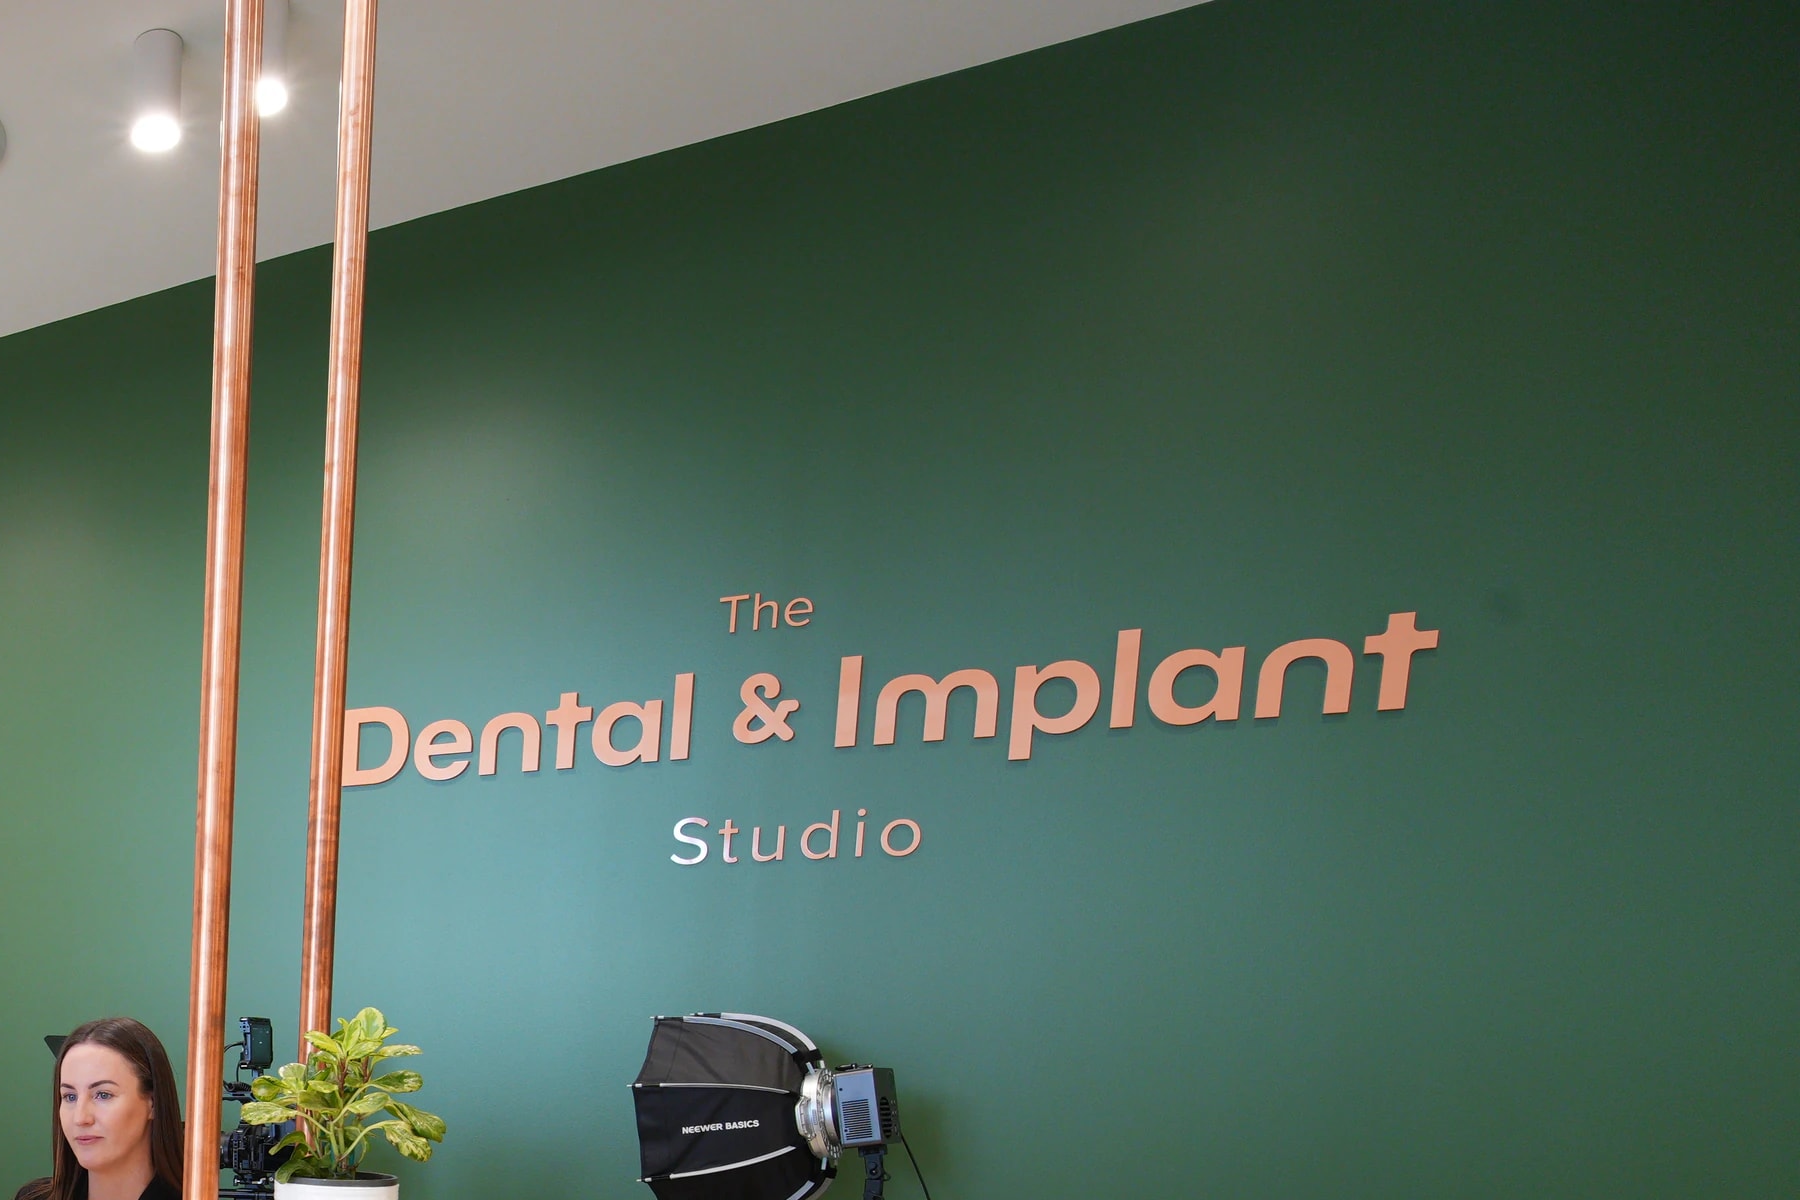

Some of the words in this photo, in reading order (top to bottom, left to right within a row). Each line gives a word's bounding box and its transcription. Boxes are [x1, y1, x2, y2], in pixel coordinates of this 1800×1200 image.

[719, 592, 814, 633] The
[341, 673, 695, 787] Dental
[732, 672, 800, 744] &
[834, 611, 1440, 761] Implant
[670, 808, 922, 865] Studio
[682, 1123, 723, 1134] NEEWER
[725, 1120, 760, 1130] BASICS
